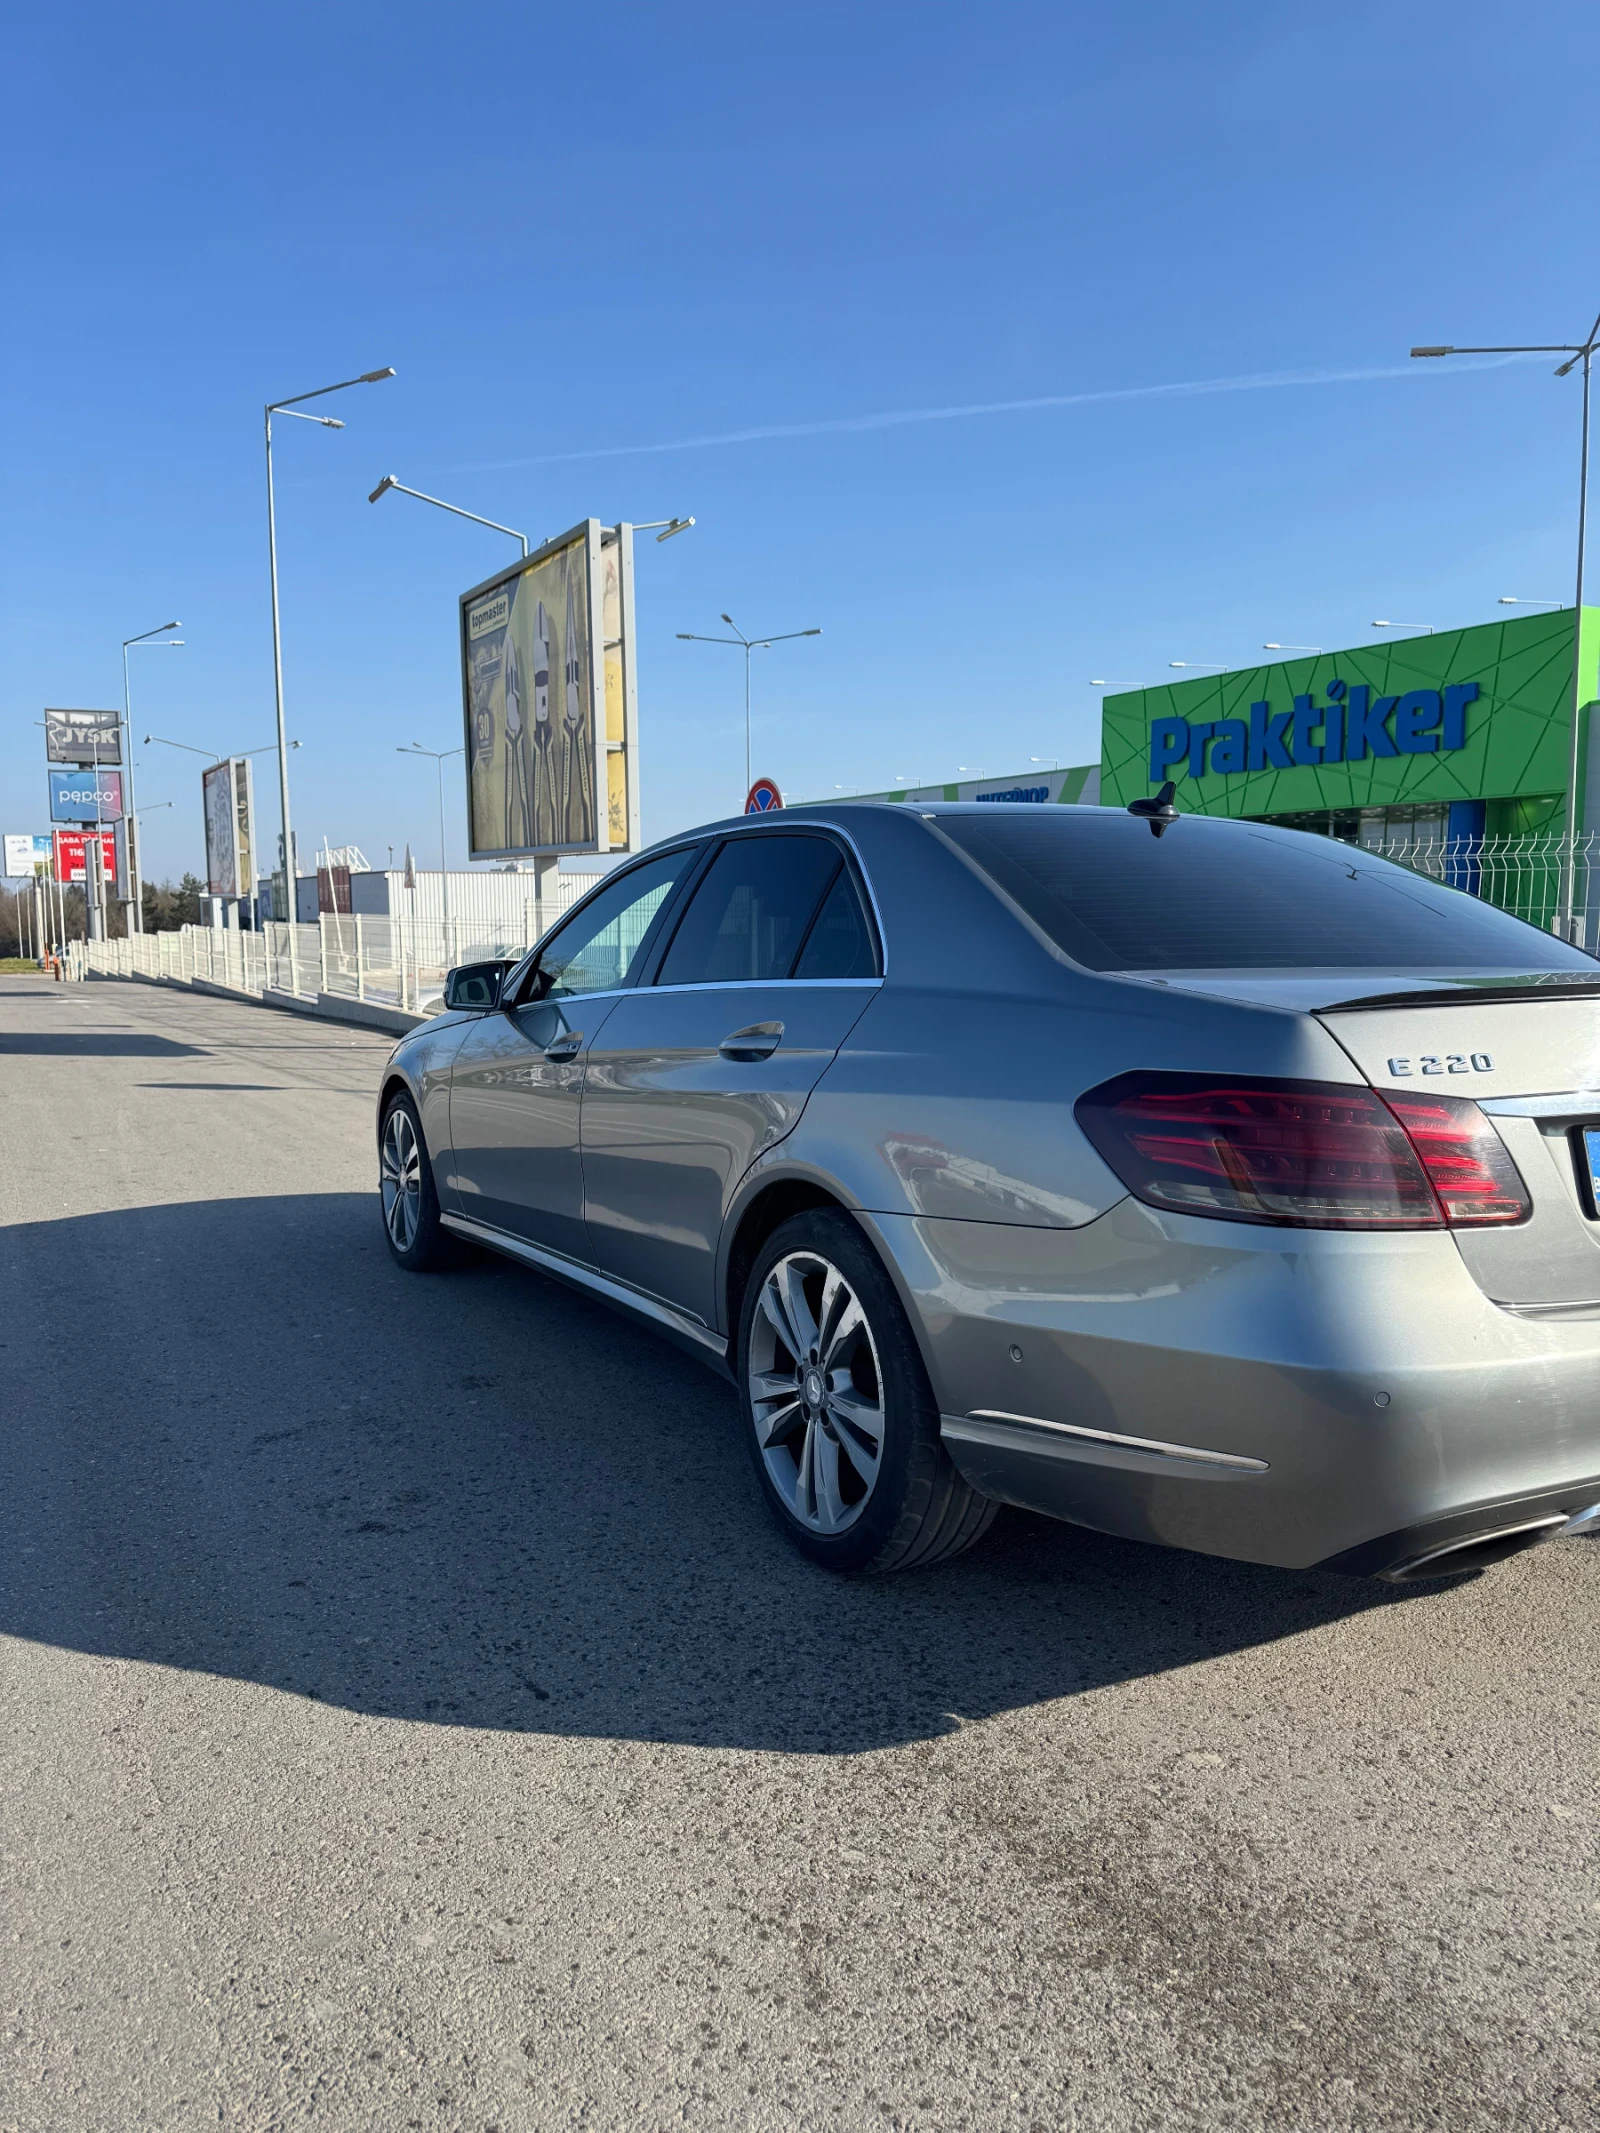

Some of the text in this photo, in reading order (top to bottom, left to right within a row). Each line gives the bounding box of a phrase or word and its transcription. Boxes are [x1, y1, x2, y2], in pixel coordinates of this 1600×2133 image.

[472, 601, 506, 629] topmaster
[62, 728, 116, 743] JYSK
[479, 713, 489, 741] 30
[1150, 679, 1479, 782] Praktiker
[1387, 1052, 1496, 1076] E 220
